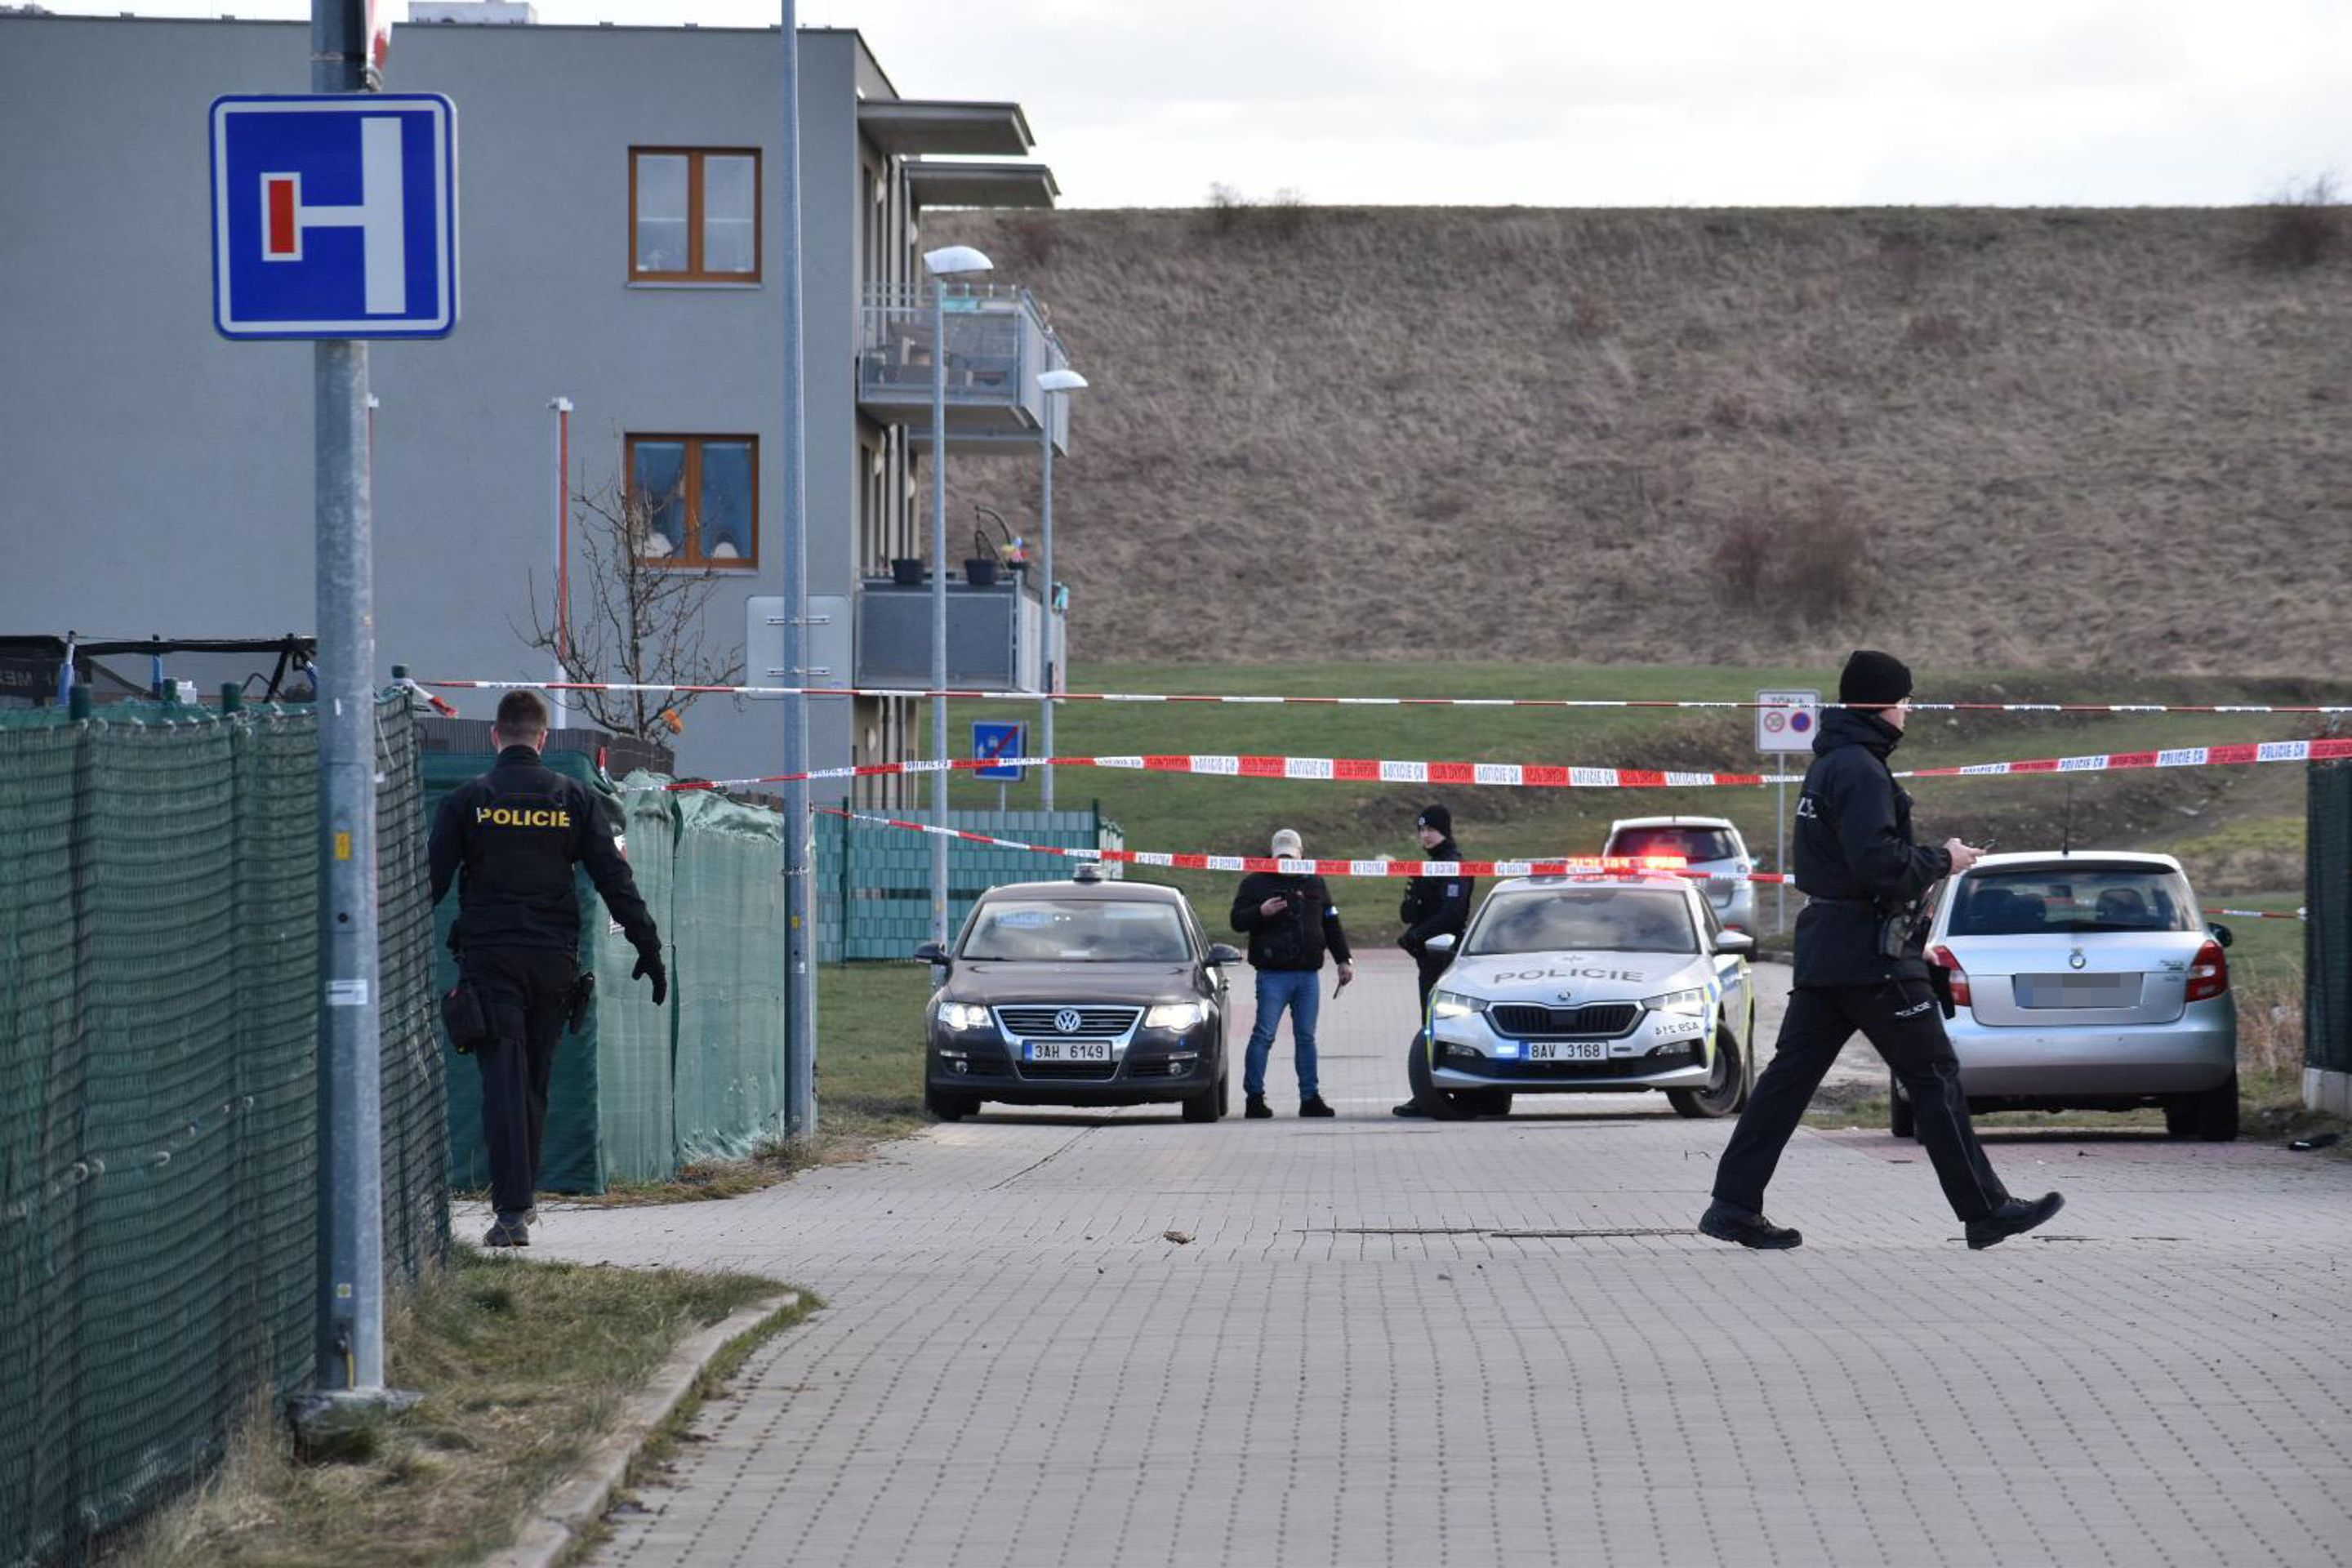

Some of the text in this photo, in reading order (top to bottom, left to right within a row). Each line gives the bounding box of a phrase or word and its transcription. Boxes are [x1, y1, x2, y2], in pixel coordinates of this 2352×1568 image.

[476, 807, 570, 827] POLICIE
[1494, 969, 1645, 983] POLICIE
[1036, 1045, 1103, 1058] 3AH 6149
[1531, 1044, 1600, 1058] 8AV 3168
